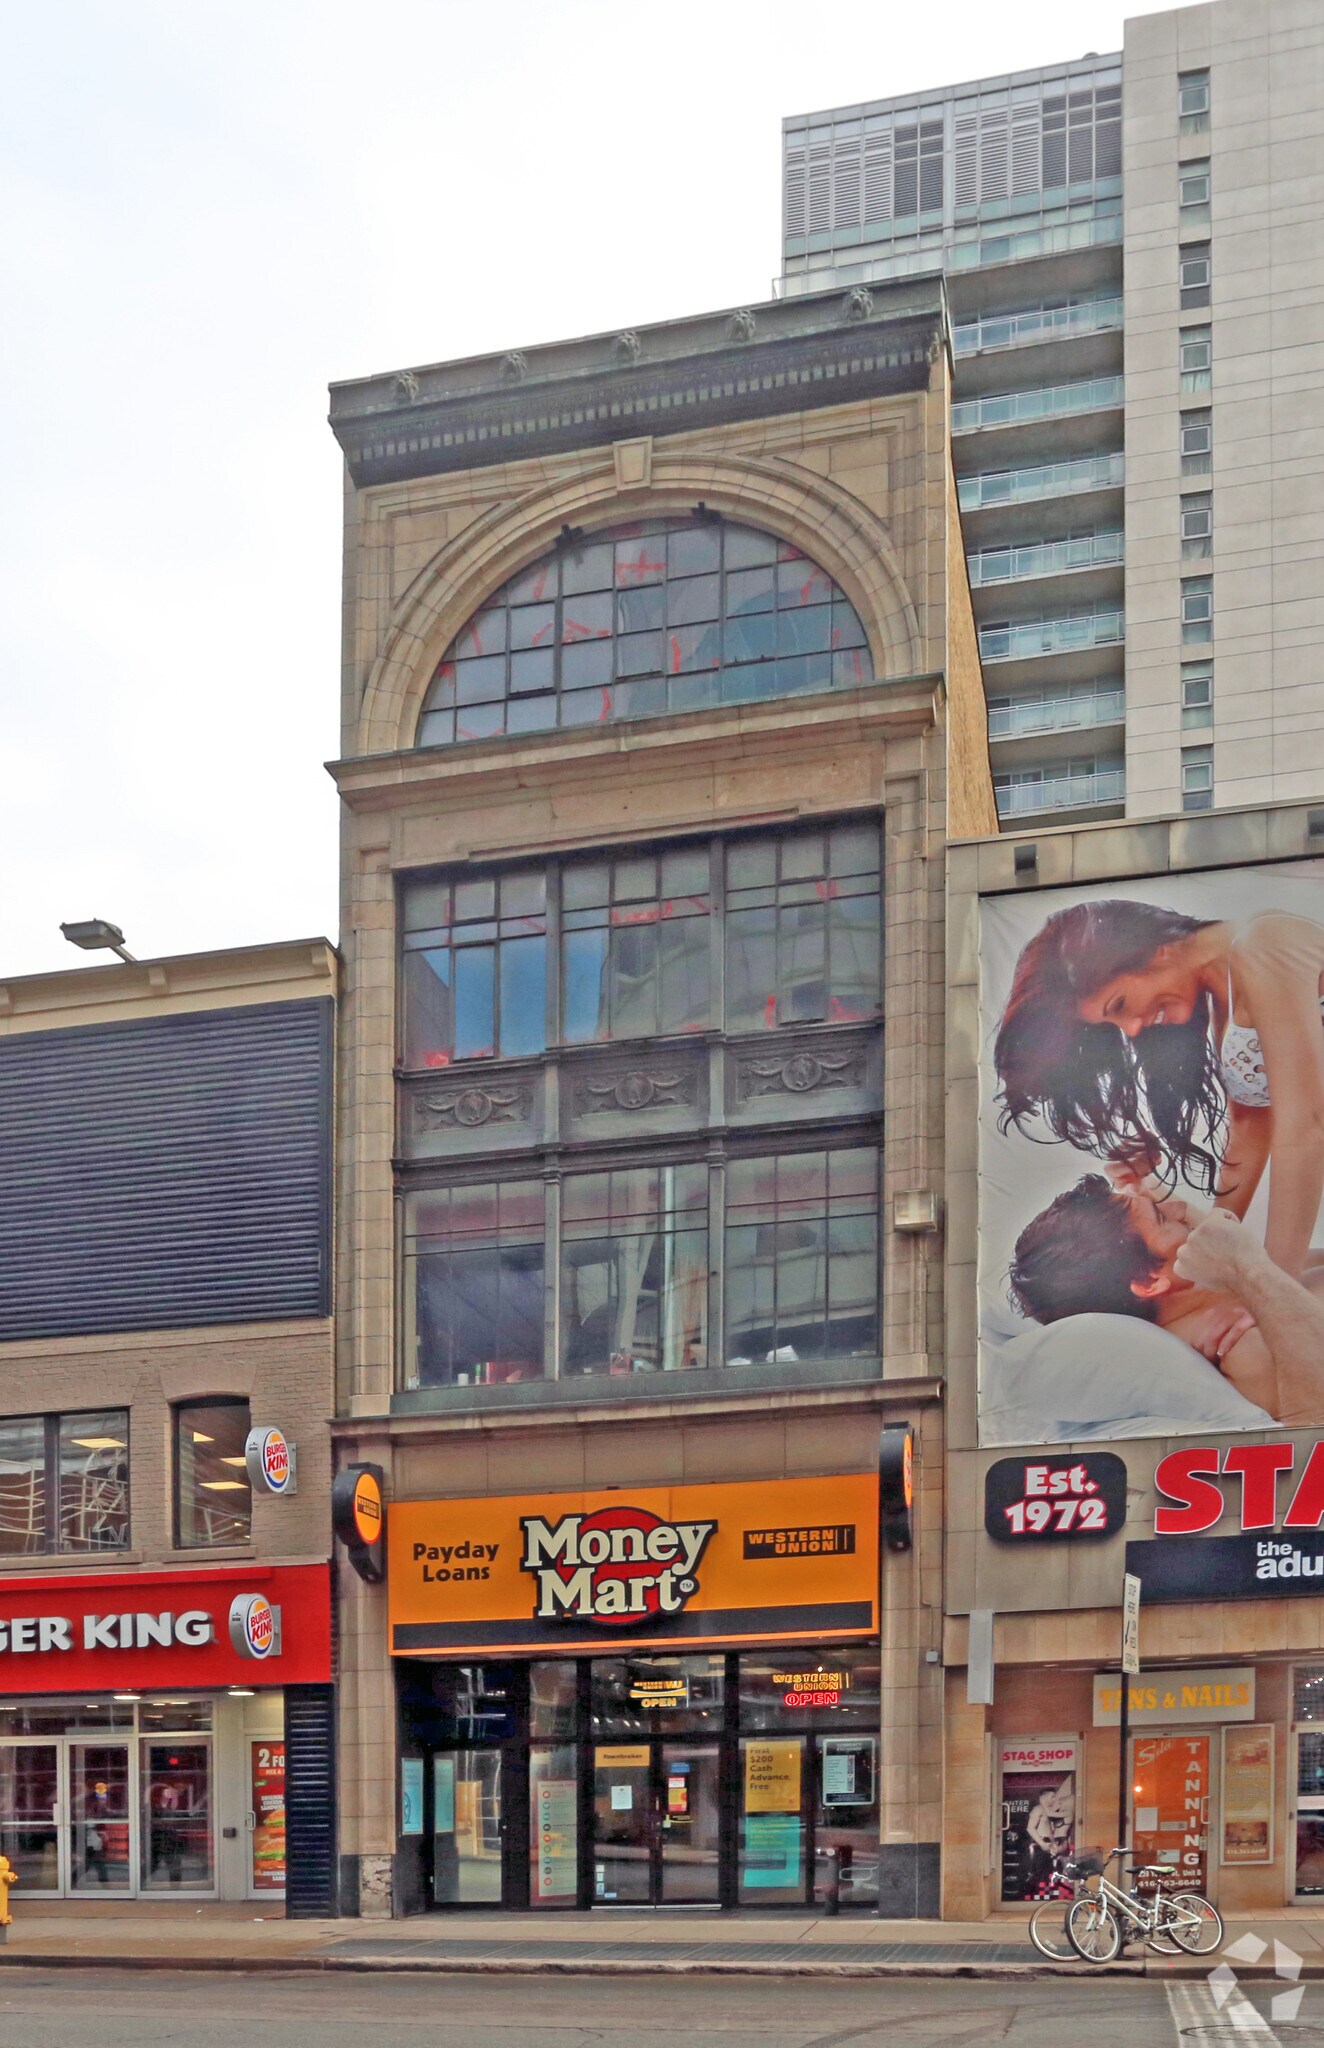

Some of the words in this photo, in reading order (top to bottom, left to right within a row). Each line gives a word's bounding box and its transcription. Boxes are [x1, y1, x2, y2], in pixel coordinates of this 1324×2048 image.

[266, 1443, 287, 1457] BURGE
[1025, 1464, 1099, 1496] Est.
[1005, 1498, 1107, 1533] 1972
[748, 1529, 834, 1545] WESTERN
[412, 1541, 499, 1562] Payday
[523, 1516, 714, 1576] Money
[775, 1541, 834, 1554] UNION
[1256, 1541, 1293, 1557] the
[1256, 1550, 1324, 1579] adu
[422, 1564, 490, 1583] Loans
[537, 1568, 682, 1617] Mart
[84, 1610, 212, 1649] KING
[772, 1673, 839, 1683] WESTERN
[793, 1681, 839, 1691] UNION
[641, 1698, 677, 1708] OPEN
[784, 1692, 839, 1707] OPEN
[1163, 1692, 1176, 1709] &
[1181, 1683, 1250, 1708] NAILS
[258, 1748, 270, 1768] 2
[750, 1755, 774, 1763] $200
[1002, 1750, 1035, 1761] STAG
[1039, 1749, 1073, 1760] SHOP
[750, 1764, 772, 1772] Cash
[1183, 1741, 1202, 1866] TANNING
